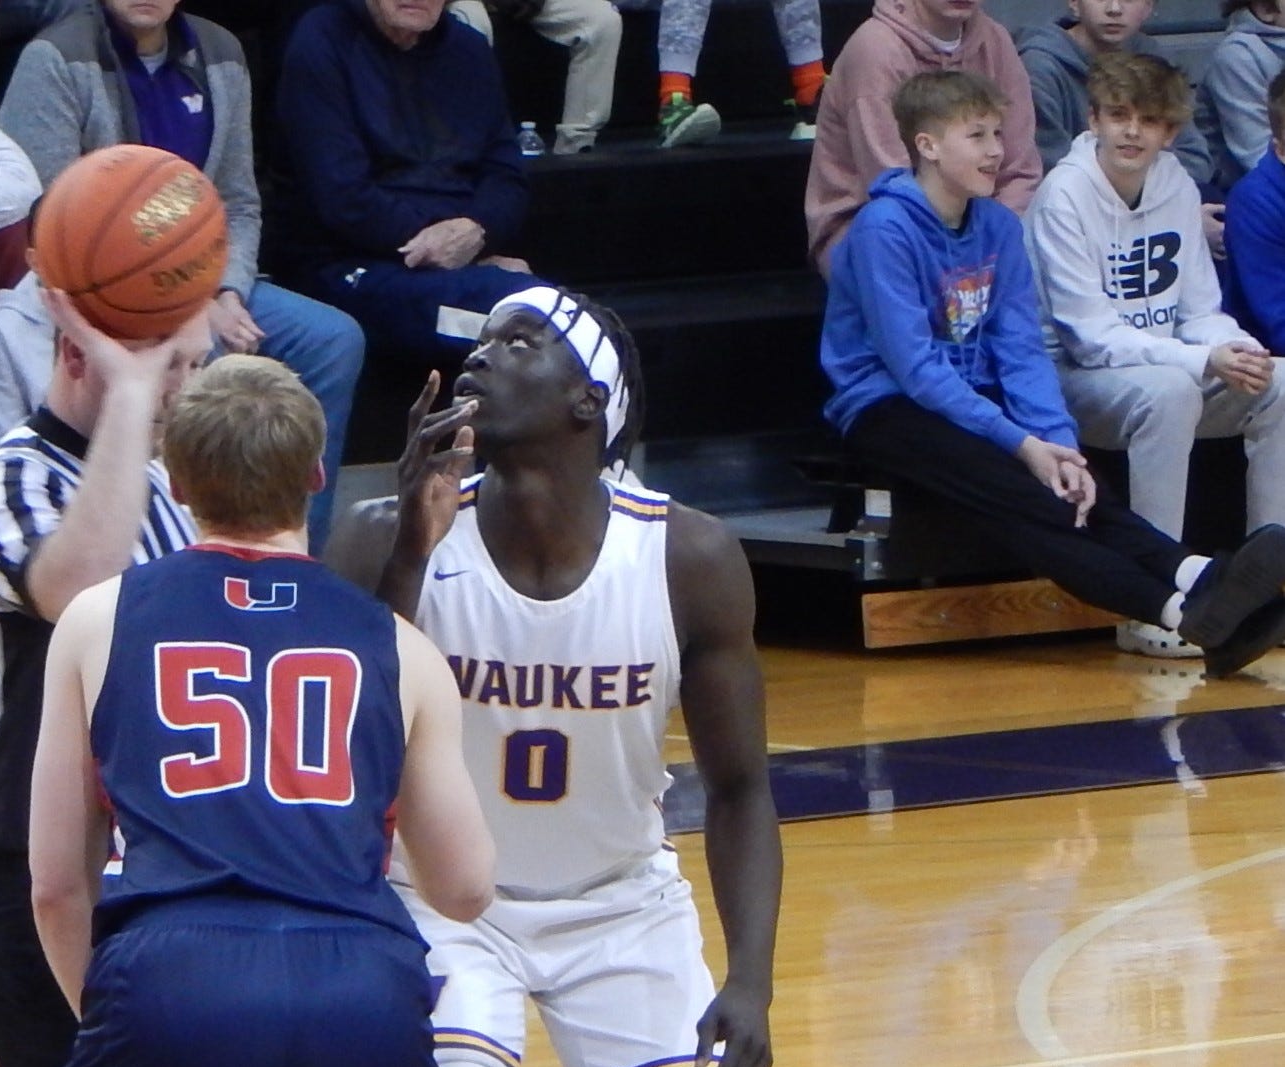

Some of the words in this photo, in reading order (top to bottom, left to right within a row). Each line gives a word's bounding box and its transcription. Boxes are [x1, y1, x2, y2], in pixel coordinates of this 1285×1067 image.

[225, 577, 297, 611] U
[154, 641, 363, 806] 50
[500, 728, 571, 806] 0
